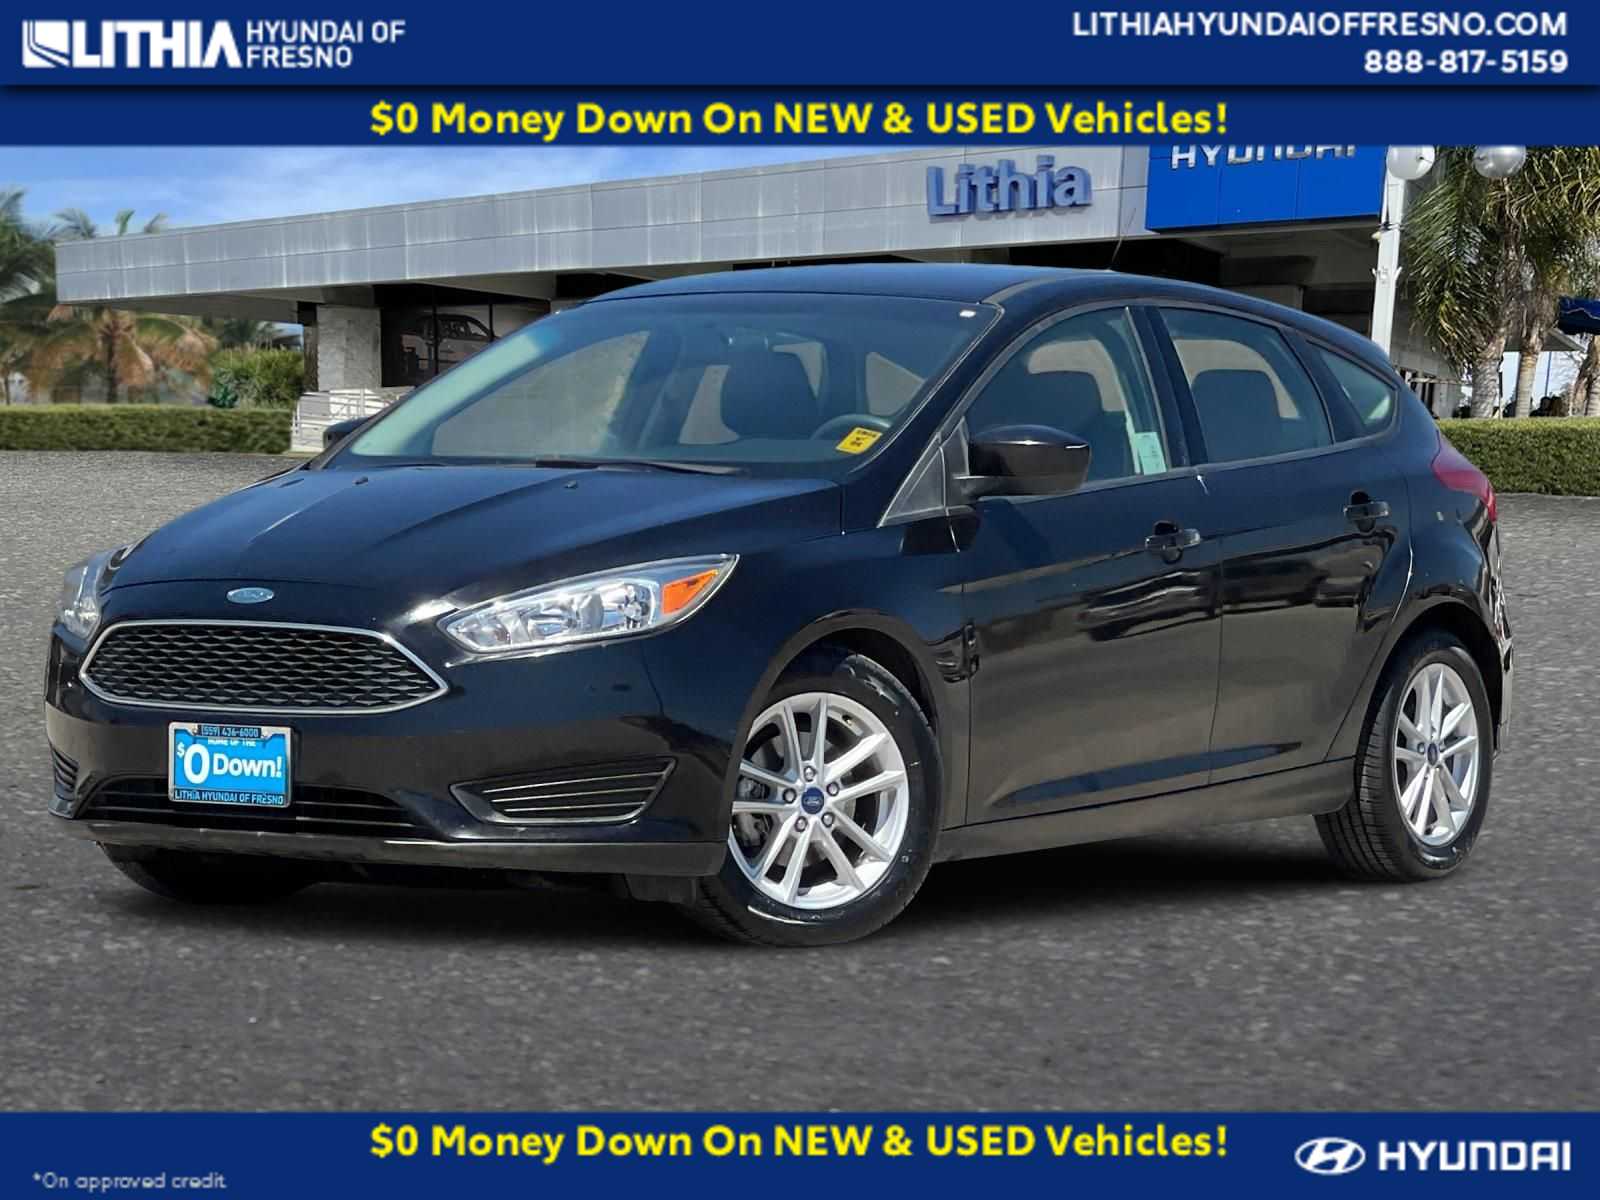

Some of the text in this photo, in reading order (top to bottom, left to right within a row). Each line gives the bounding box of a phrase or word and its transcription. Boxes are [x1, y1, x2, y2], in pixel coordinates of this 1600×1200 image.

[927, 155, 1092, 216] Lithia
[213, 753, 283, 778] Down!
[175, 790, 284, 805] LITHIA HYUNDAI OF FRESNO
